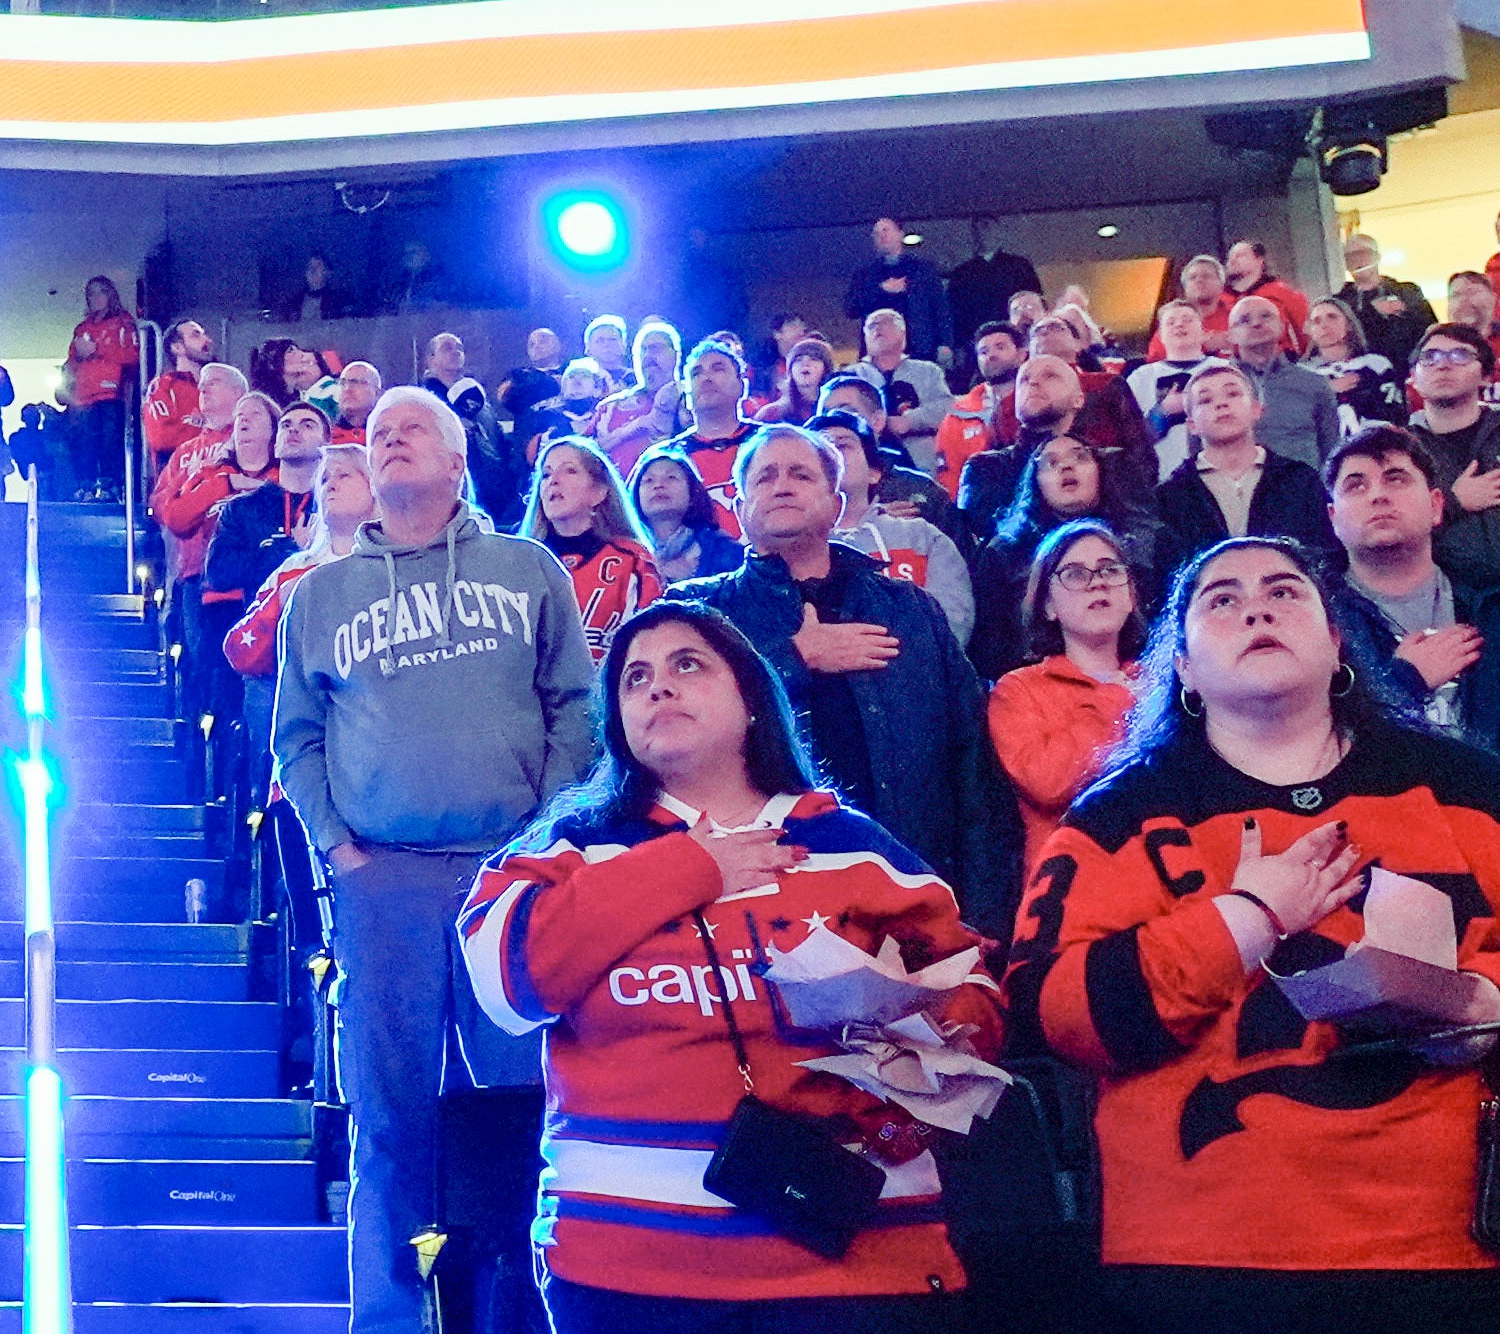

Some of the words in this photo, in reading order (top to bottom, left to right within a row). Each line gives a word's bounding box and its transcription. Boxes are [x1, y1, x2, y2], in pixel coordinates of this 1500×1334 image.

[598, 555, 623, 585] C
[333, 583, 443, 681] OCEAN
[453, 580, 532, 646] CITY
[378, 637, 498, 672] MARYLAND
[1144, 829, 1206, 899] C
